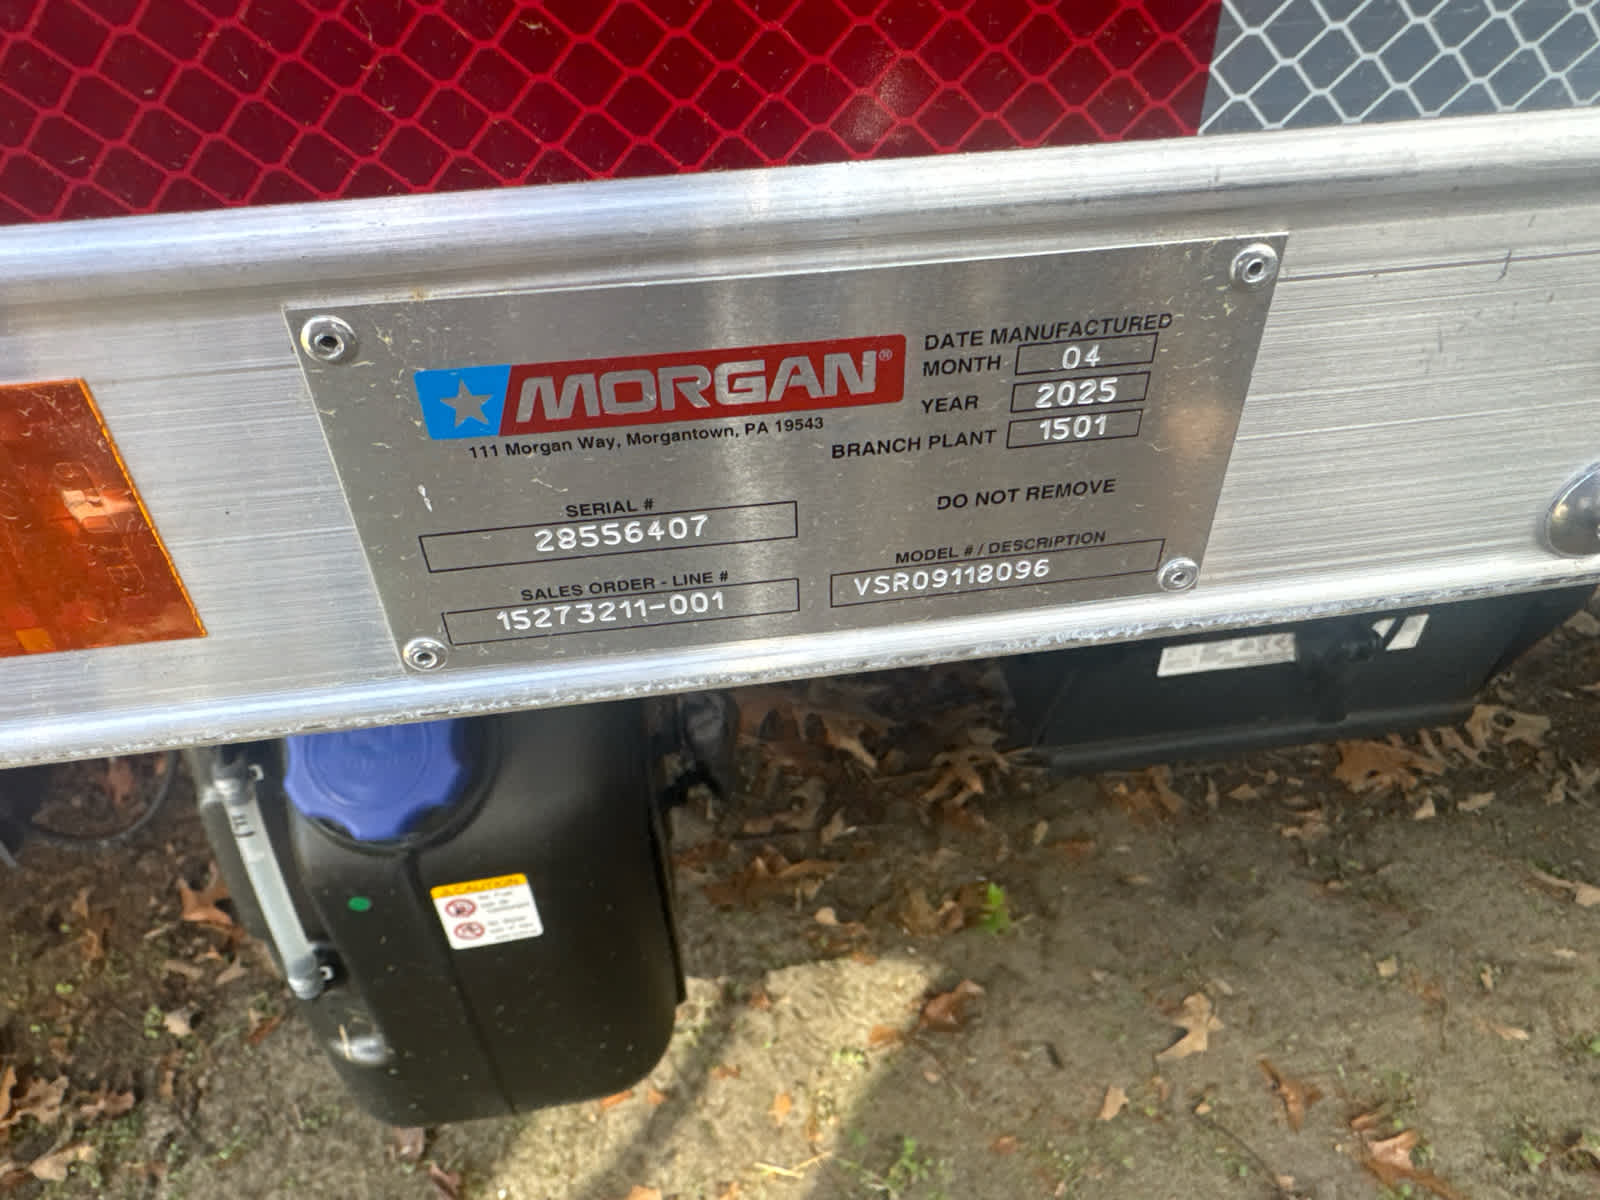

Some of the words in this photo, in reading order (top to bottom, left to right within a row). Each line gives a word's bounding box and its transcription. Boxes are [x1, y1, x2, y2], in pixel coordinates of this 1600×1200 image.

[924, 331, 984, 350] DATE
[990, 313, 1173, 345] MANUFACTURED
[922, 355, 1001, 376] MONTH
[1061, 344, 1101, 370] 04
[921, 395, 979, 414] YEAR
[1035, 377, 1119, 409] 2025
[469, 444, 500, 460] 111
[505, 436, 573, 458] Morgan
[577, 432, 621, 454] Way,
[626, 424, 739, 449] Morgantown,
[744, 421, 769, 436] PA
[775, 416, 824, 433] 19543
[831, 437, 921, 459] BRANCH
[928, 430, 997, 449] PLANT
[1039, 415, 1107, 440] 1501
[566, 500, 639, 518] SERIAL
[643, 498, 654, 511] #
[937, 494, 968, 510] DO
[975, 488, 1019, 506] NOT
[1026, 479, 1116, 501] REMOVE
[534, 514, 709, 553] 28556407
[895, 546, 959, 564] MODEL
[964, 544, 974, 555] #
[988, 530, 1106, 555] DESCRIPTION
[521, 584, 583, 601] SALES
[589, 578, 656, 595] ORDER
[673, 573, 716, 588] LINE
[719, 570, 729, 583] #
[854, 558, 1051, 596] VSR09118096
[496, 591, 726, 632] 15273211-001
